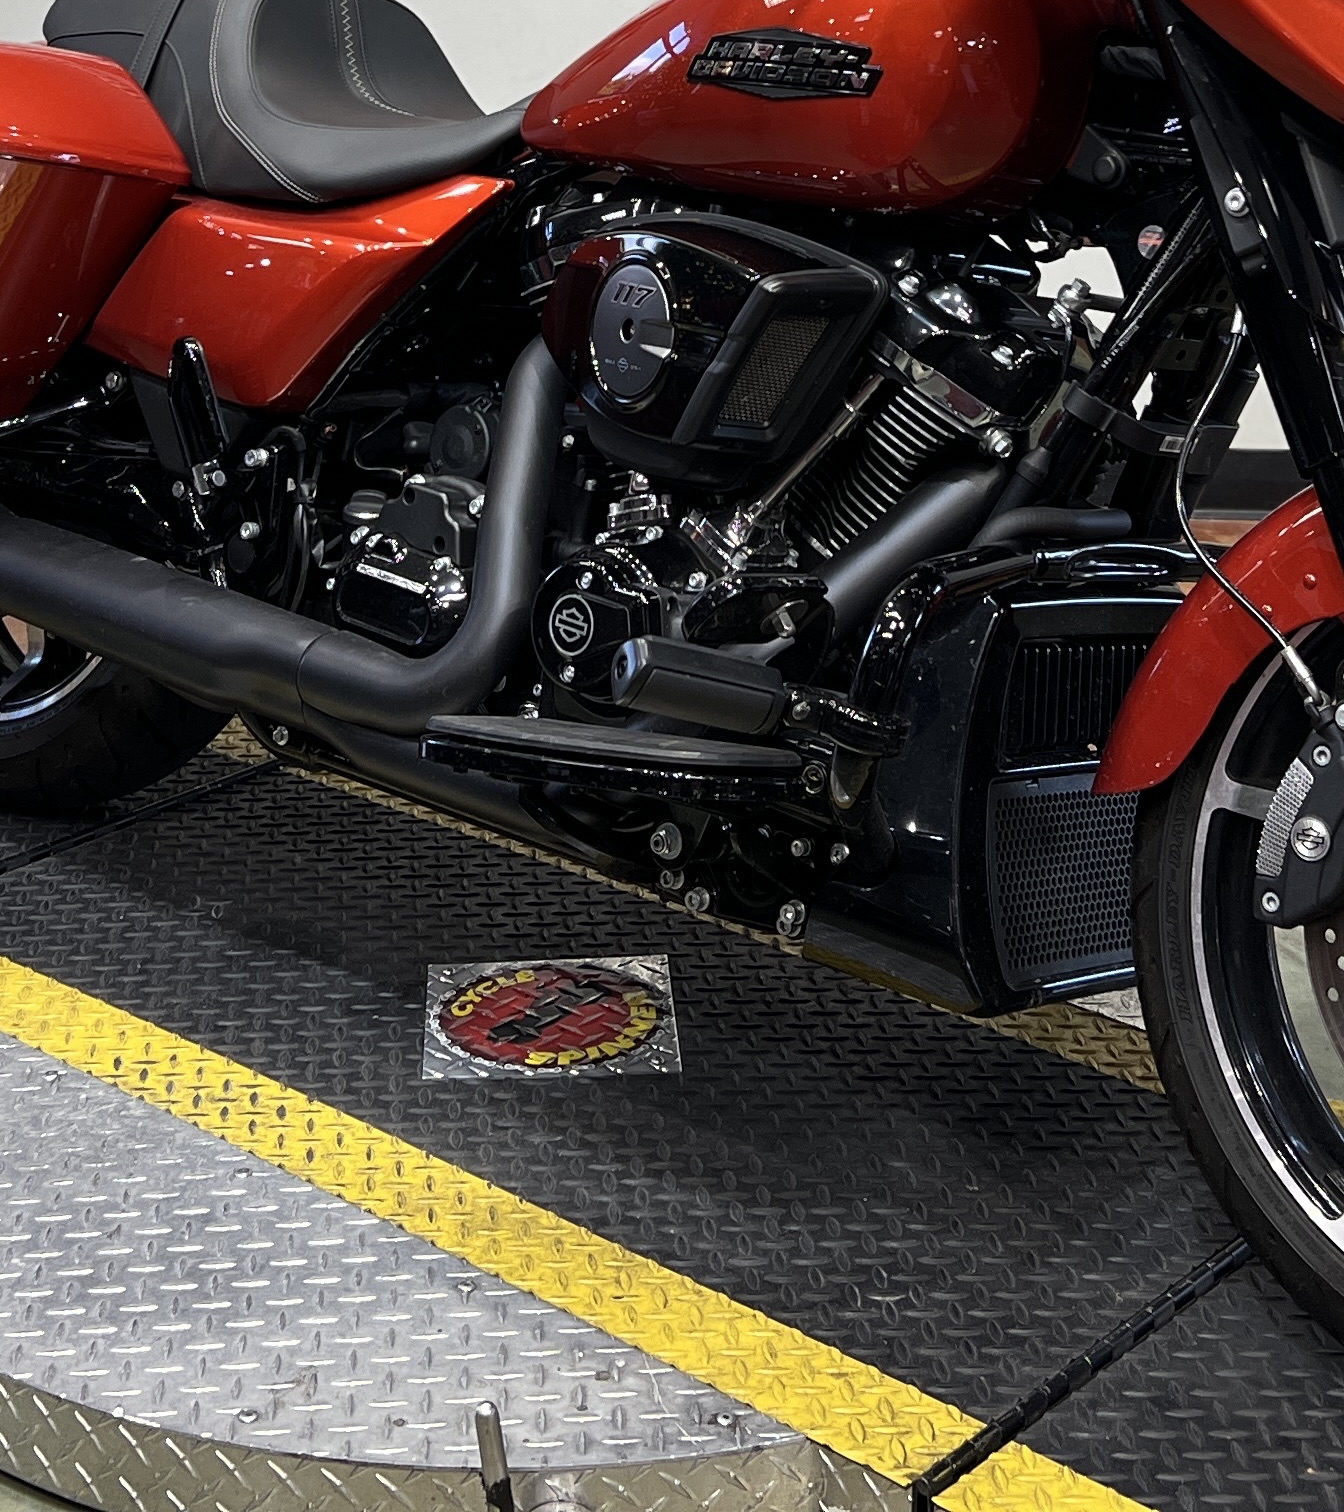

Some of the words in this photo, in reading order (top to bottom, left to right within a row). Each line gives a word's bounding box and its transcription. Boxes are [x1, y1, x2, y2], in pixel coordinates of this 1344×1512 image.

[691, 59, 871, 89] DAVIDSON
[609, 282, 657, 309] 117
[450, 969, 536, 1017] CYCLE
